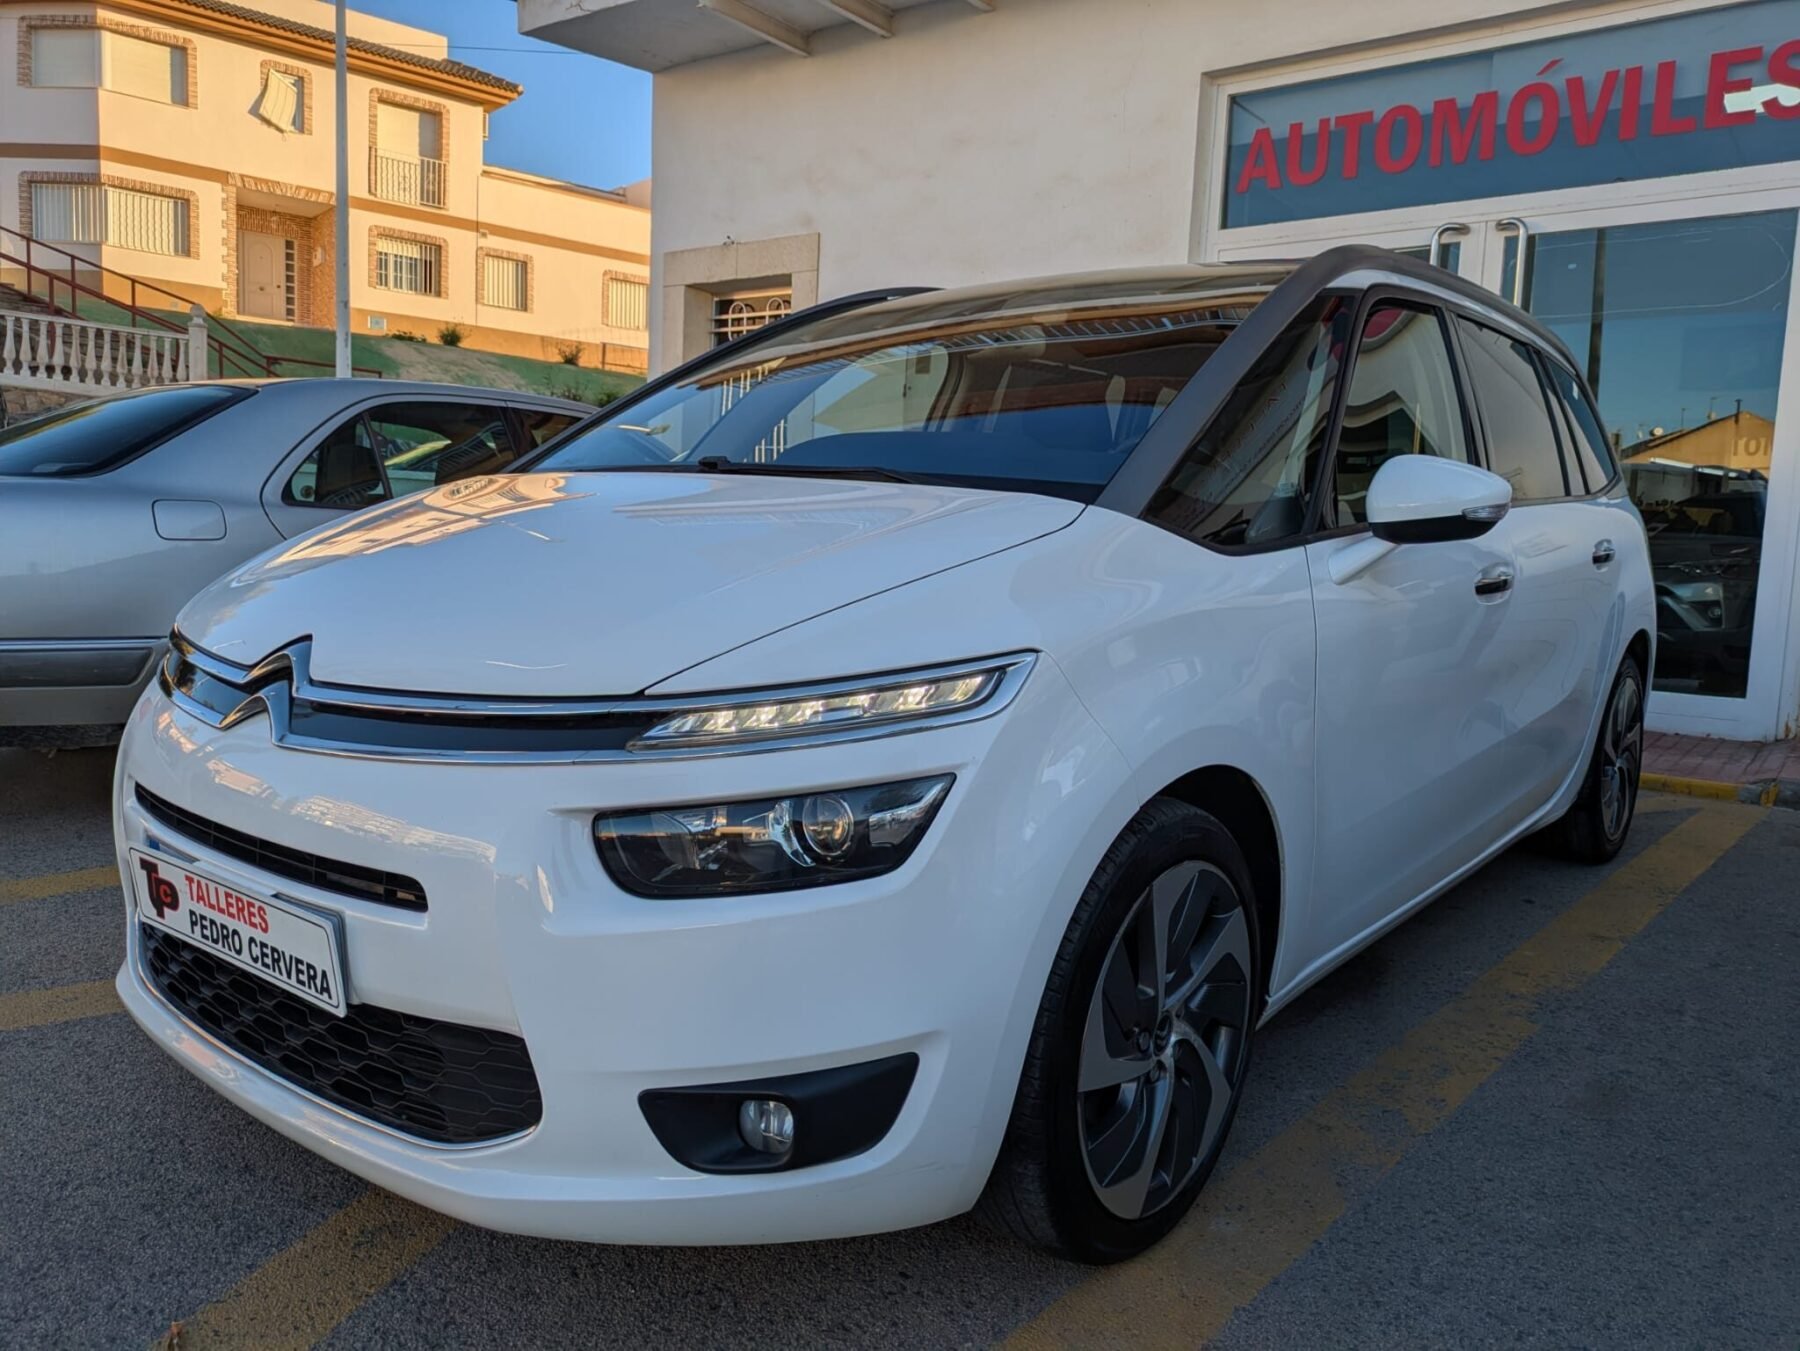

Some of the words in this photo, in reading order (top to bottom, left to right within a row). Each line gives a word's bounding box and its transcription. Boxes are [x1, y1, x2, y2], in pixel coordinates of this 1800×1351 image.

[1236, 39, 1800, 194] AUTOMÓVILES
[184, 874, 270, 934] TALLERES
[188, 908, 243, 956] PEDRO
[247, 936, 333, 1001] CERVERA
